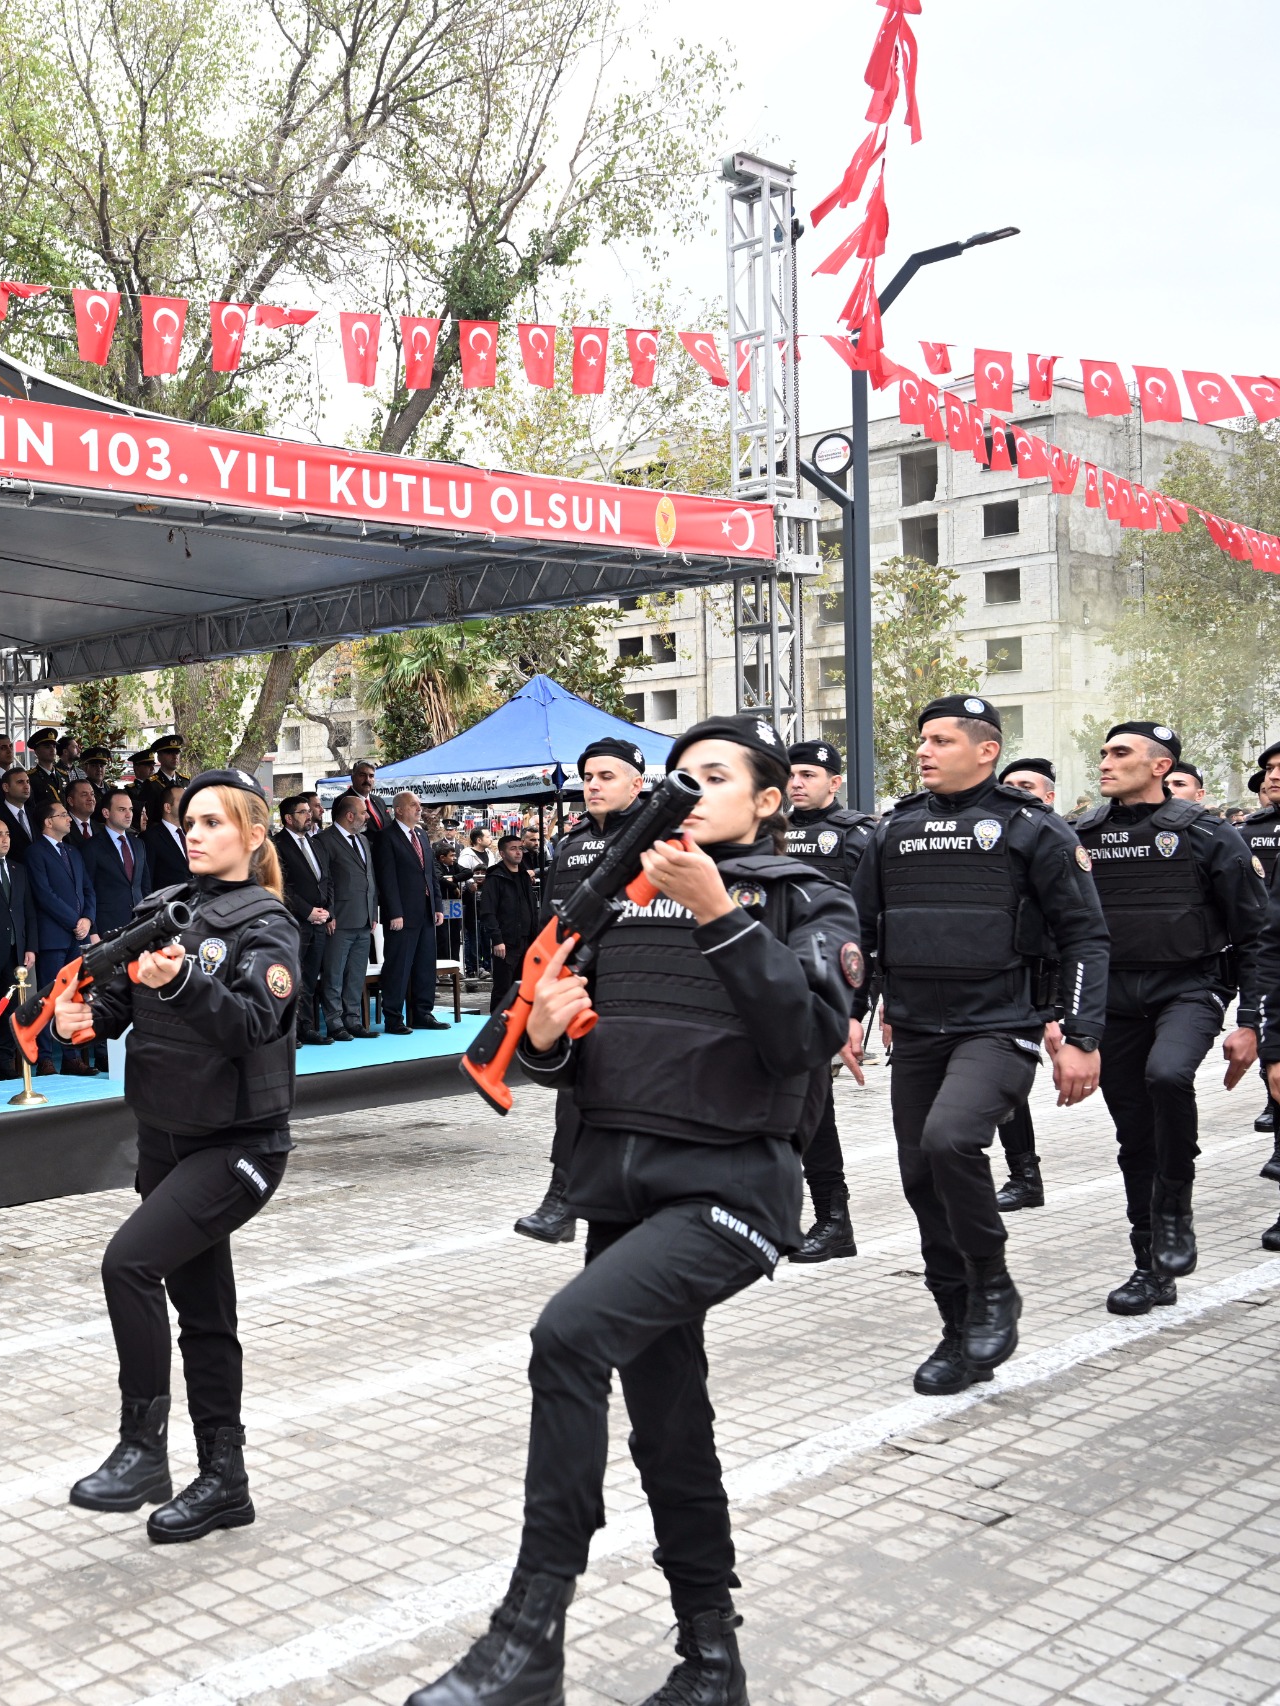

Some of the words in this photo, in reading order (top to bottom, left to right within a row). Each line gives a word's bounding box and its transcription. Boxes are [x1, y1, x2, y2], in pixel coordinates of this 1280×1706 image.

[79, 428, 188, 484] 103.
[209, 446, 306, 500] YILI
[330, 465, 472, 519] KUTLU
[490, 486, 620, 534] OLSUN
[371, 785, 423, 797] ramanmaraş
[929, 836, 973, 850] KUVVET
[1112, 845, 1151, 859] KUVVET
